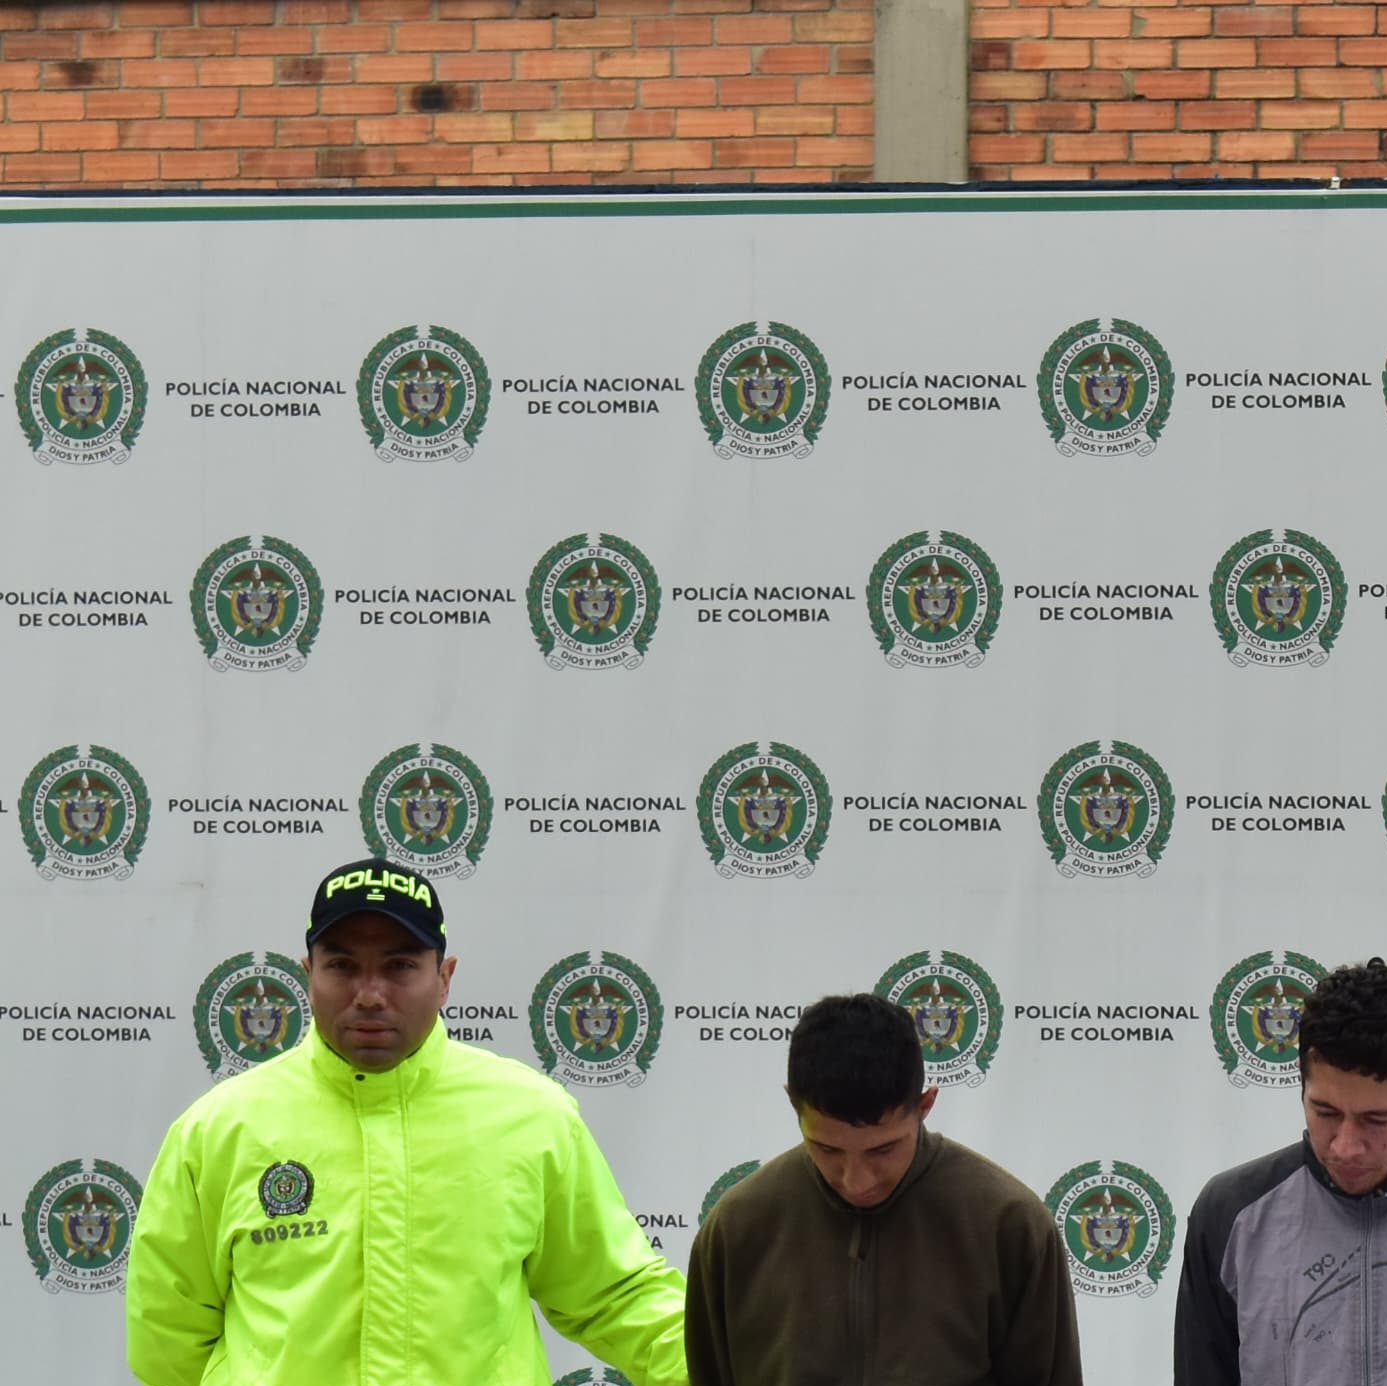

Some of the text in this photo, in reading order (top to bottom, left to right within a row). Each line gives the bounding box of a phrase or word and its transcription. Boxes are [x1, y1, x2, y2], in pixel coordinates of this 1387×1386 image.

[166, 378, 346, 396] POLICÍA NACIONAL
[843, 371, 1027, 389] POLICÍA NACIONAL
[191, 403, 321, 417] DE COLOMBIA
[868, 397, 1000, 411] DE COLOMBIA
[251, 551, 266, 559] DE
[276, 557, 307, 611] COLOMBIA
[1015, 580, 1199, 598] POLICÍA NACIONAL
[336, 585, 516, 603] POLICÍA NACIONAL
[360, 611, 490, 624] DE COLOMBIA
[1040, 607, 1173, 620] DE COLOMBIA
[258, 623, 302, 655] NACIONAL
[258, 653, 292, 669] PATRIA
[505, 793, 686, 811] POLICÍA NACIONAL
[1187, 791, 1371, 809] POLICÍA NACIONAL
[530, 819, 660, 832] DE COLOMBIA
[1212, 818, 1345, 831] DE COLOMBIA
[0, 1001, 176, 1019] POLICÍA NACIONAL
[1015, 1001, 1199, 1019] POLICÍA NACIONAL
[23, 1028, 151, 1041] DE COLOMBIA
[1041, 1028, 1174, 1041] DE COLOMBIA
